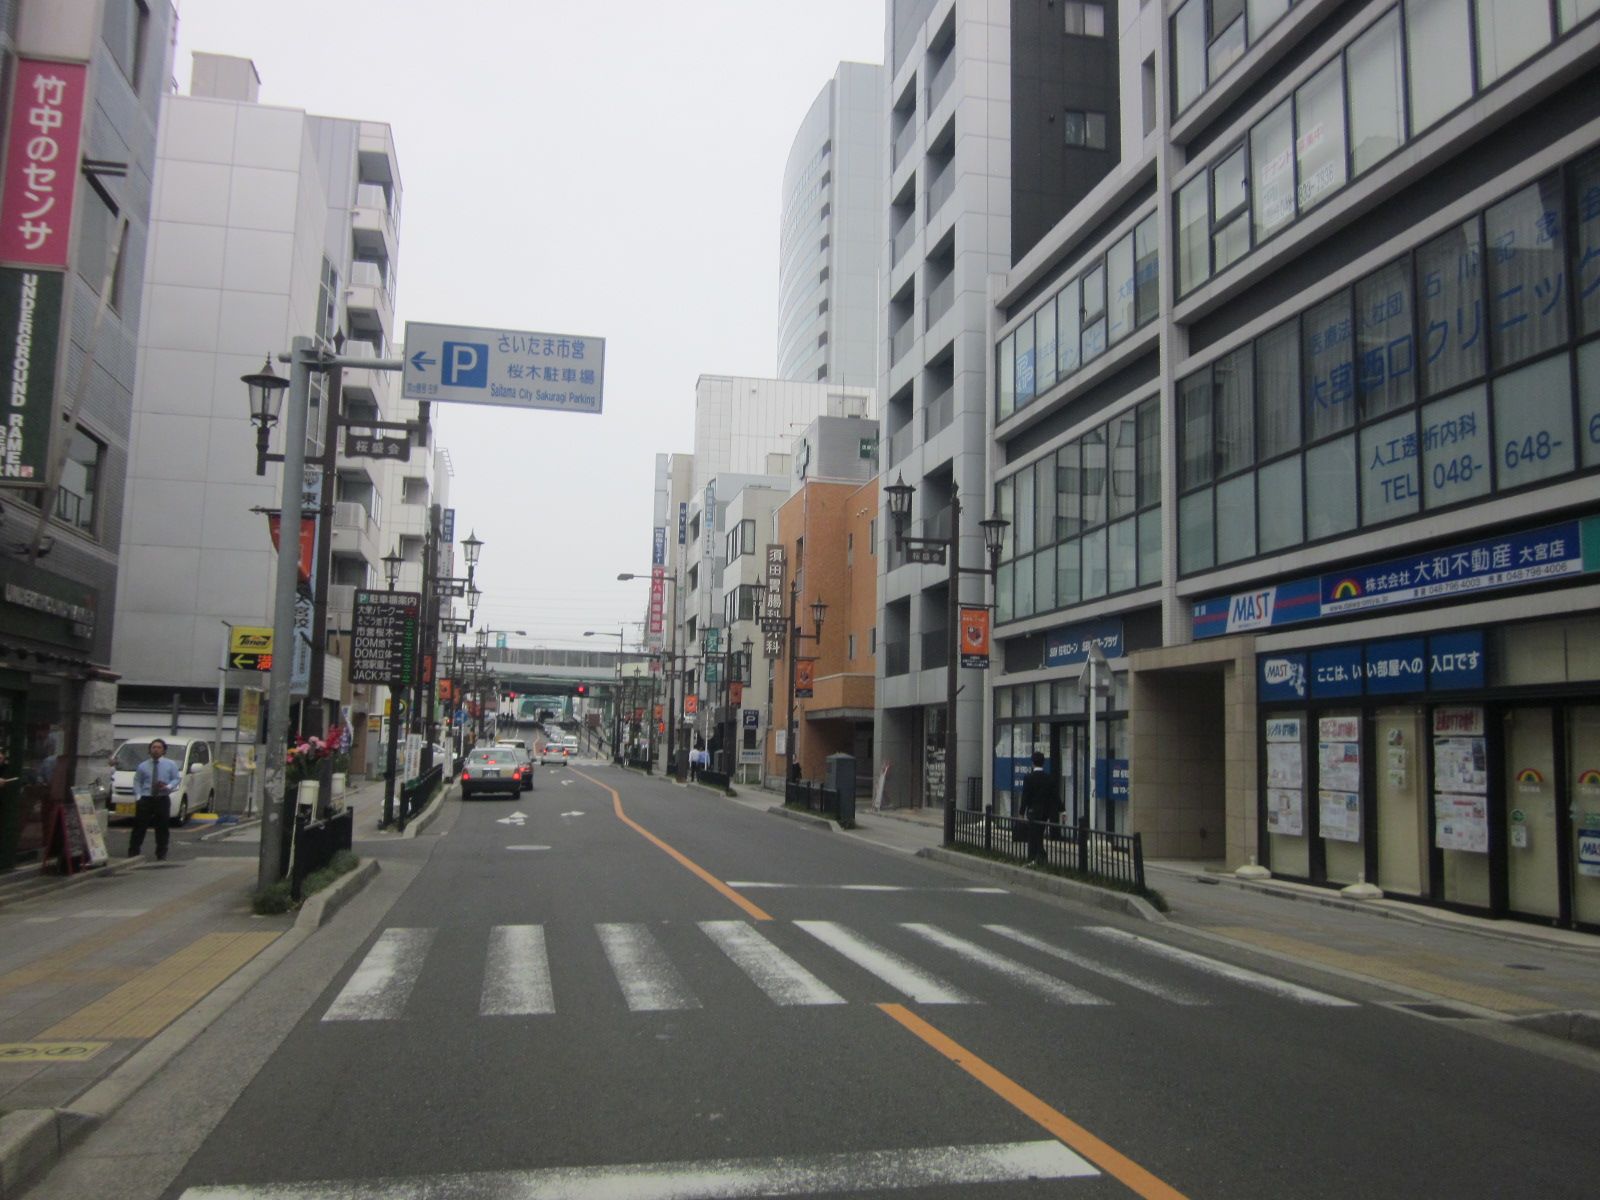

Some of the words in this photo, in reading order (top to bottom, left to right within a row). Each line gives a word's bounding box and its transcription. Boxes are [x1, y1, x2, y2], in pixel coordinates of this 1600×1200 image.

[17, 74, 67, 250] 竹中のセンサ
[11, 273, 38, 407] UNDERGROUND
[498, 333, 586, 361] さいたま市営
[451, 345, 478, 384] P
[507, 362, 595, 386] 桜木駐車場
[490, 382, 517, 398] Saitama
[518, 388, 533, 401] City
[535, 390, 568, 404] Sakuragi
[569, 391, 596, 406] Parking
[5, 413, 24, 478] RAMEN
[1370, 412, 1477, 471] 人工透析内科
[1380, 473, 1419, 503] TEL
[1365, 569, 1411, 593] 株式会社
[1413, 543, 1512, 584] 大和不動産
[1518, 538, 1565, 564] 大宮店
[1232, 591, 1270, 624] MAST
[1267, 664, 1288, 678] MAST
